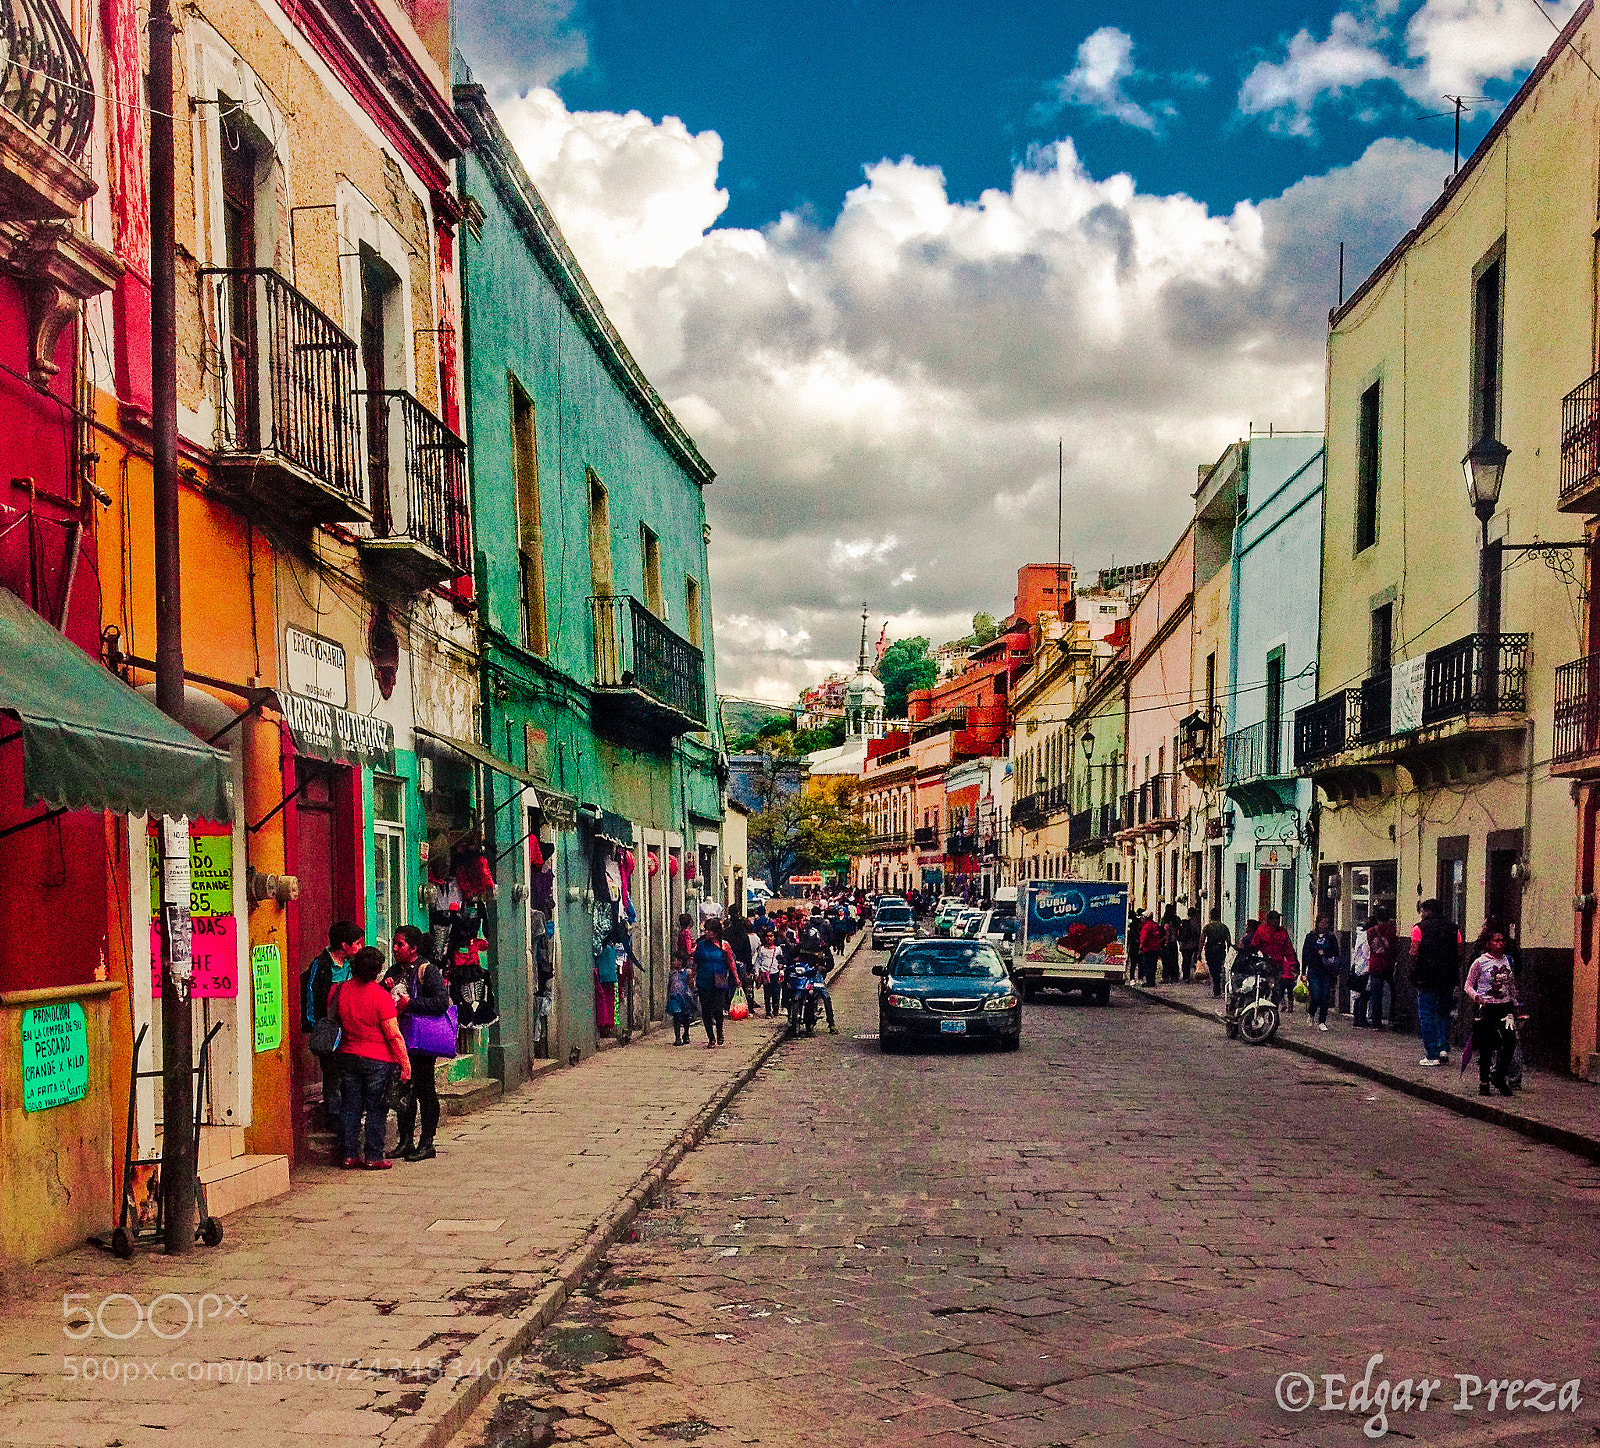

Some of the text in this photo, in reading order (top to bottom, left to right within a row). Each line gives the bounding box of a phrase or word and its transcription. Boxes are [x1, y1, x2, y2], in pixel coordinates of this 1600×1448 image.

[334, 706, 390, 753] GUTIERREZ
[191, 880, 231, 891] GRANDE
[189, 892, 211, 912] 85
[211, 975, 232, 990] 30
[256, 991, 274, 1005] FILETE
[34, 1035, 71, 1060] PESCADO
[25, 1060, 56, 1082] GRANDE
[67, 1055, 84, 1071] KILO
[26, 1088, 35, 1099] LA
